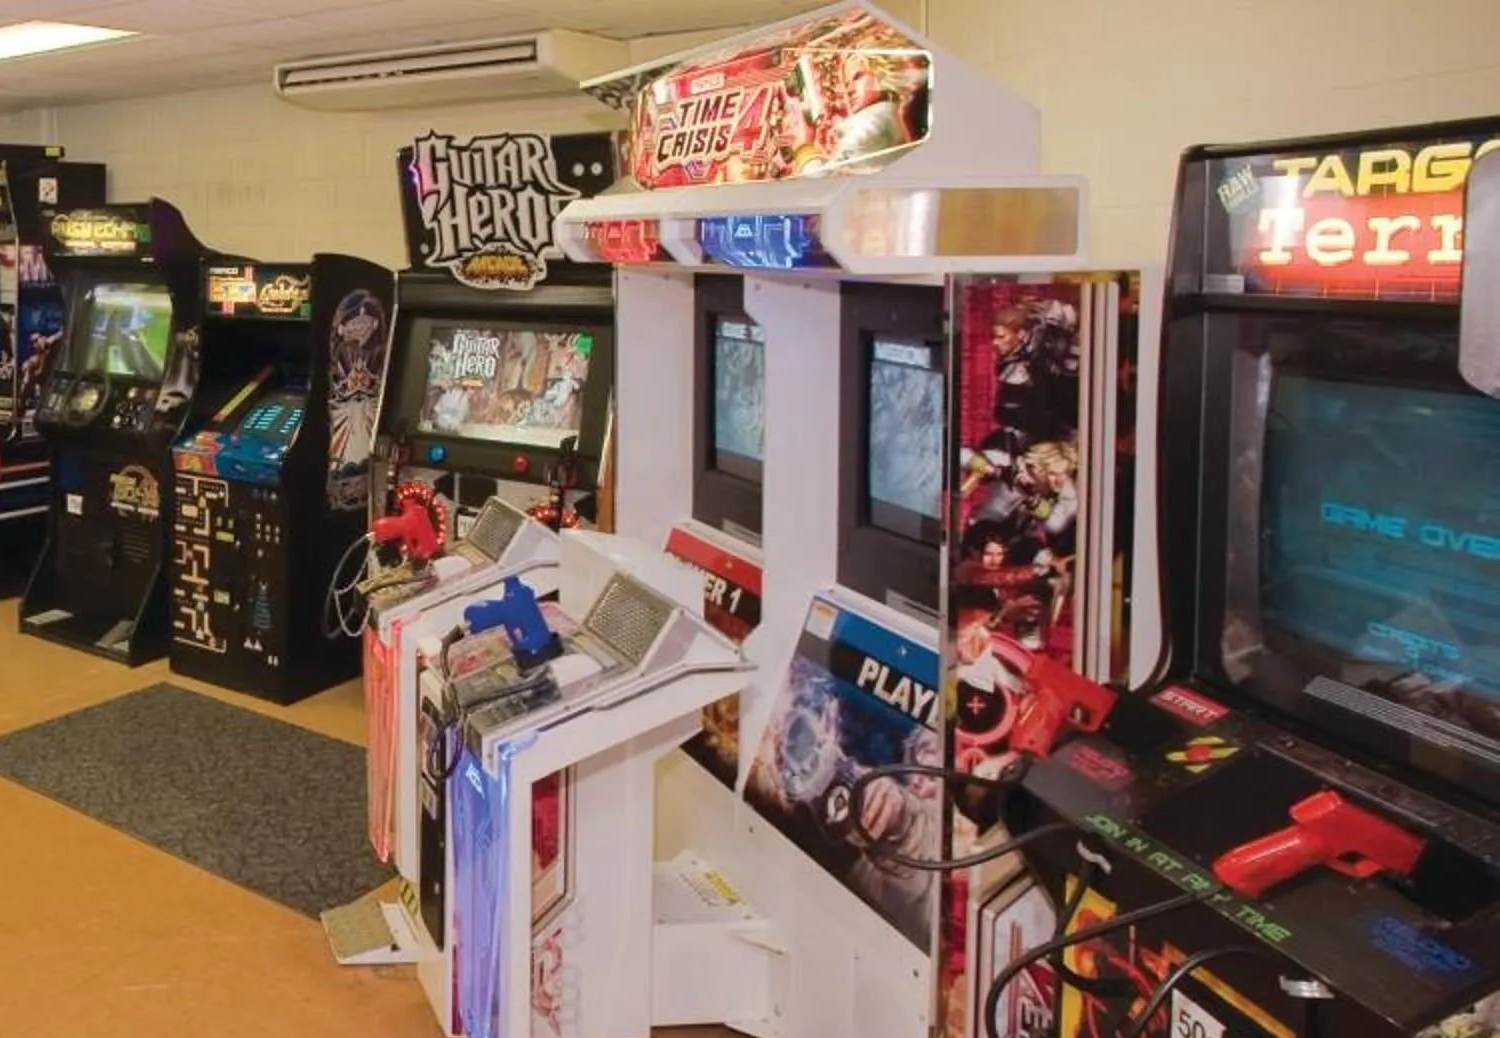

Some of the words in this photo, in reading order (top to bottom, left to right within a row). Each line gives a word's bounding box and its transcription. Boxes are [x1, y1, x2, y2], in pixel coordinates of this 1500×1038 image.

[679, 91, 741, 128] TIME
[657, 124, 732, 163] CRISIS
[414, 132, 578, 200] GUITAR
[1272, 140, 1500, 197] TARG
[430, 183, 562, 262] HERO
[453, 330, 500, 358] GUITAR
[452, 352, 497, 379] HERO
[1158, 688, 1217, 721] START
